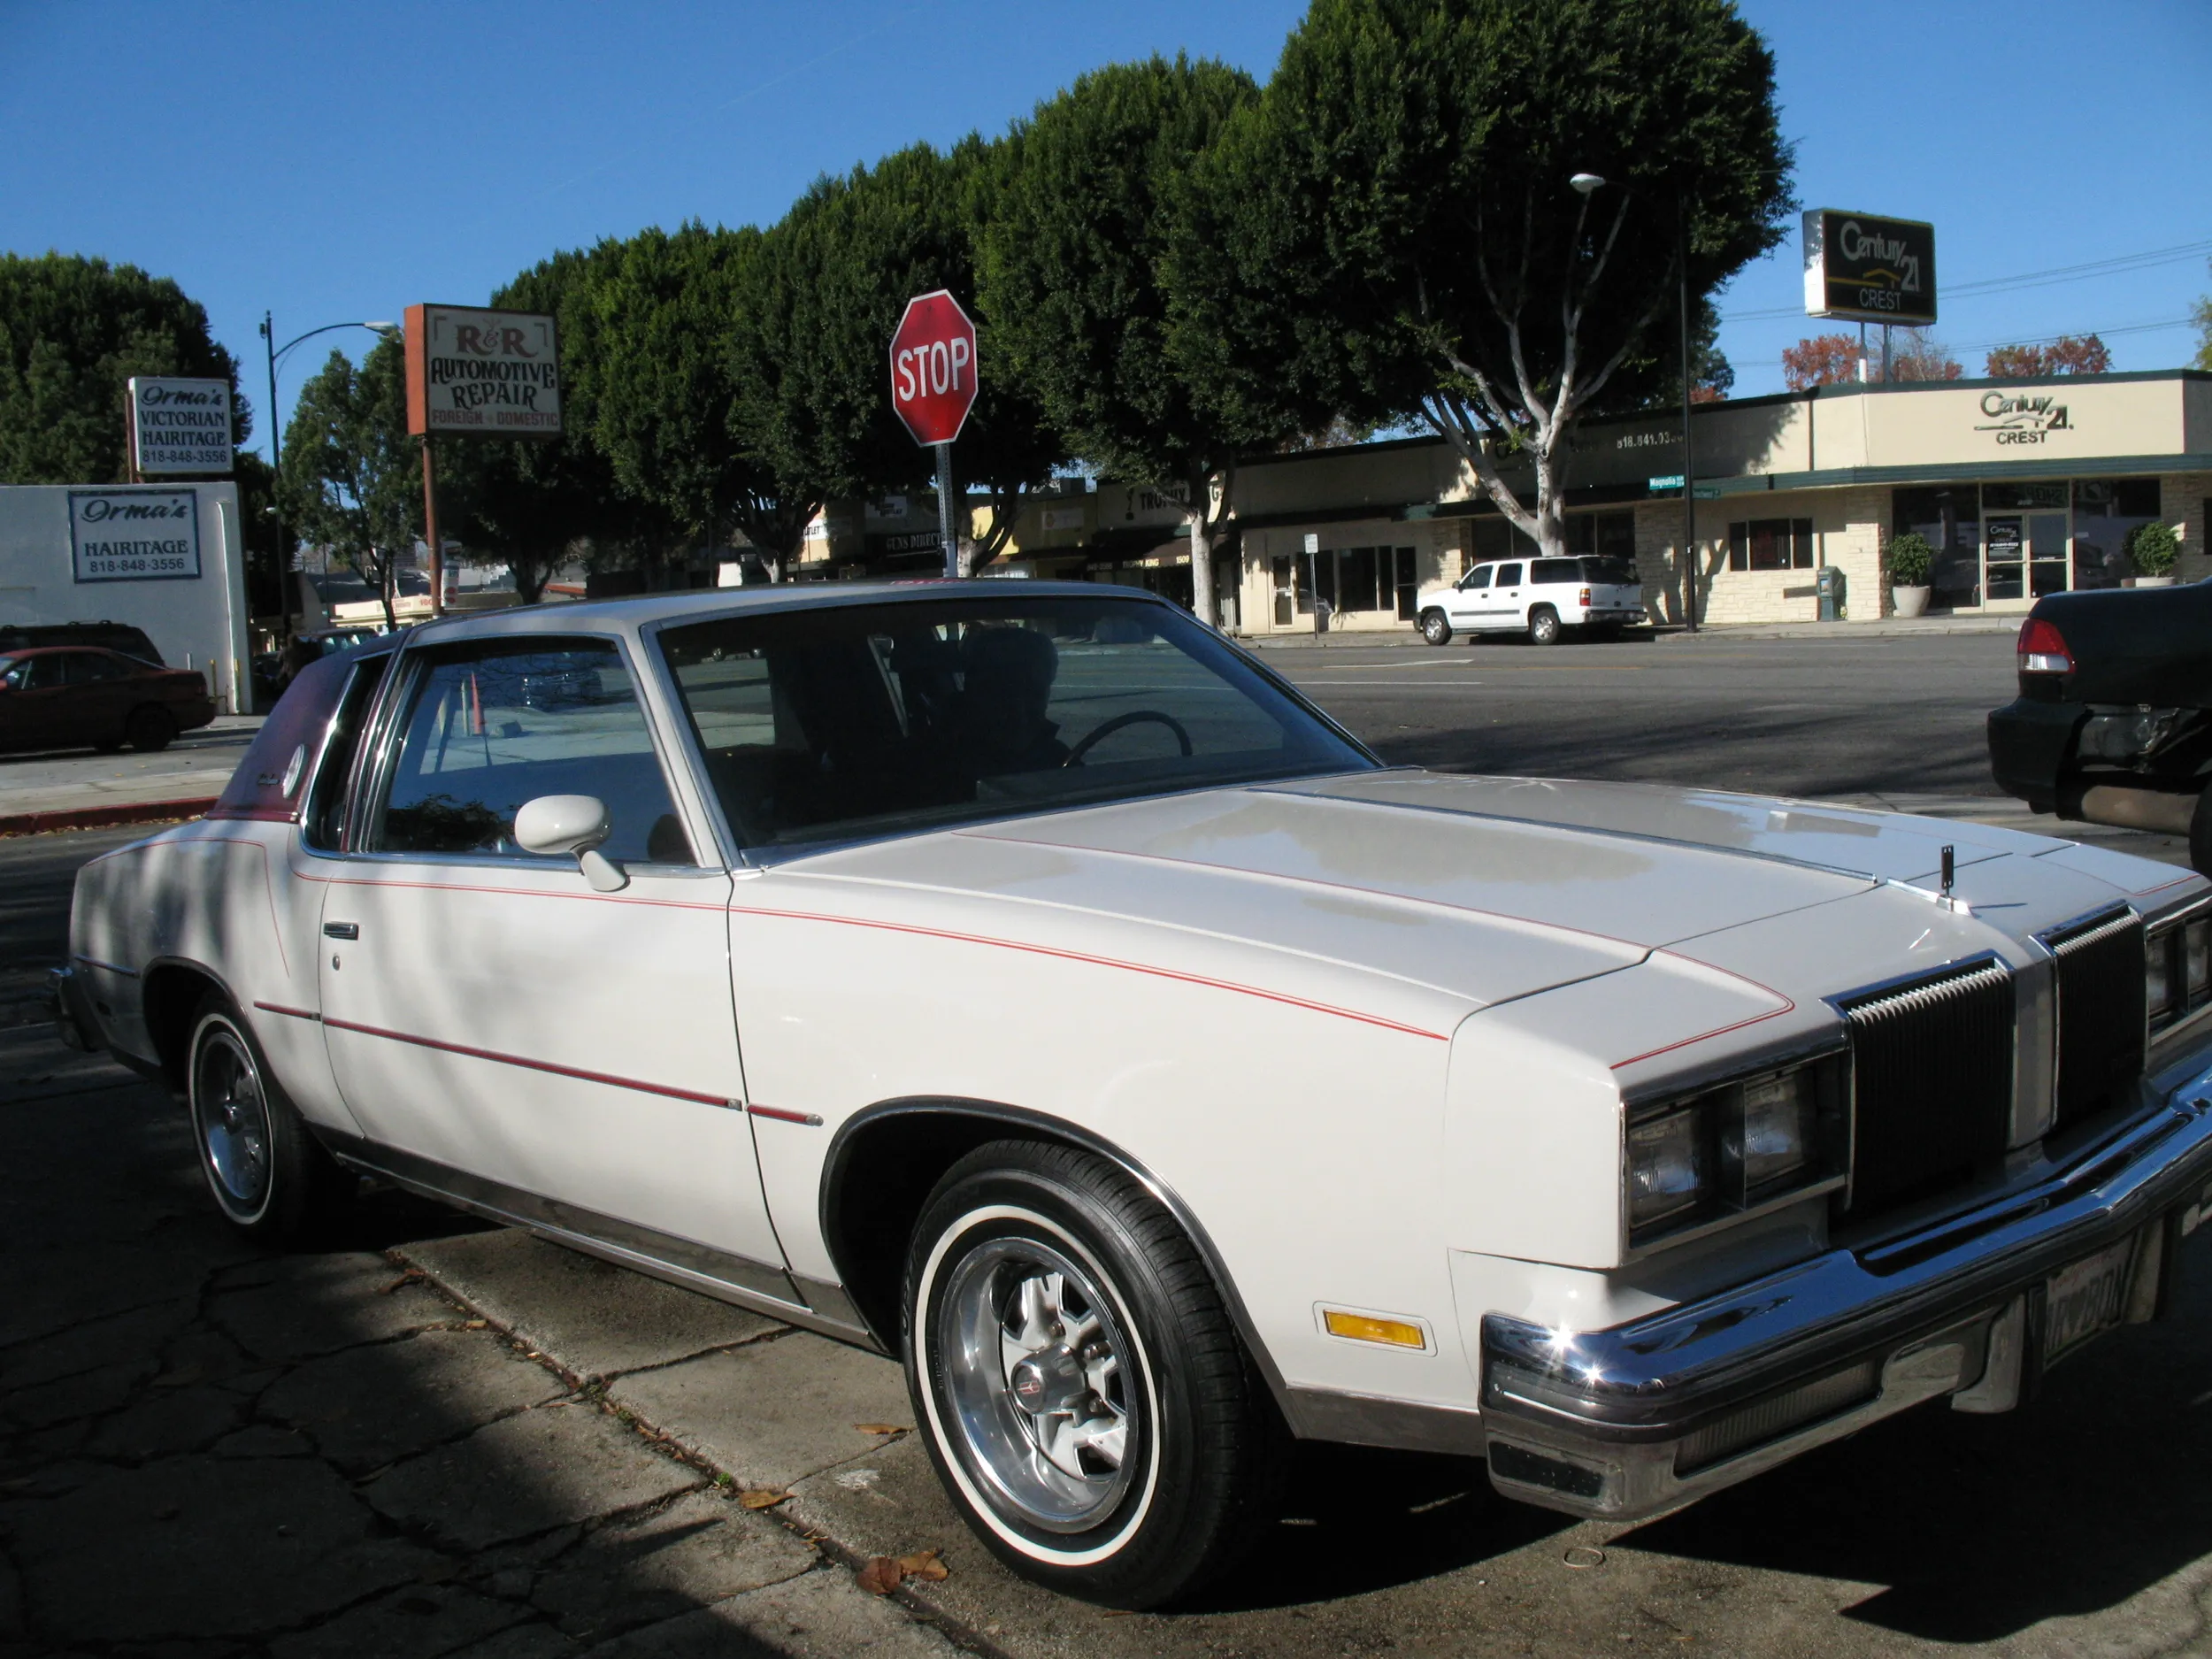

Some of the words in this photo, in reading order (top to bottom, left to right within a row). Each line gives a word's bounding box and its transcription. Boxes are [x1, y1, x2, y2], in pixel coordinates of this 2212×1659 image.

[1840, 220, 1907, 267] Century
[1900, 255, 1919, 292] 21
[1859, 288, 1901, 311] CREST
[431, 357, 556, 389] AUTOMOTIVE
[898, 337, 969, 402] STOP
[450, 382, 538, 411] REPAIR
[1980, 390, 2053, 417] Century
[141, 411, 226, 426] VICTORIAN
[432, 410, 483, 425] FOREIGN
[496, 411, 558, 426] DOMESTIC
[142, 430, 227, 446] HAIRITAGE
[1996, 430, 2048, 444] CREST
[142, 449, 227, 463] 818-848-3556
[84, 540, 188, 557] HAIRITAGE
[90, 558, 185, 572] 818-848-3556
[1145, 558, 1159, 567] KING
